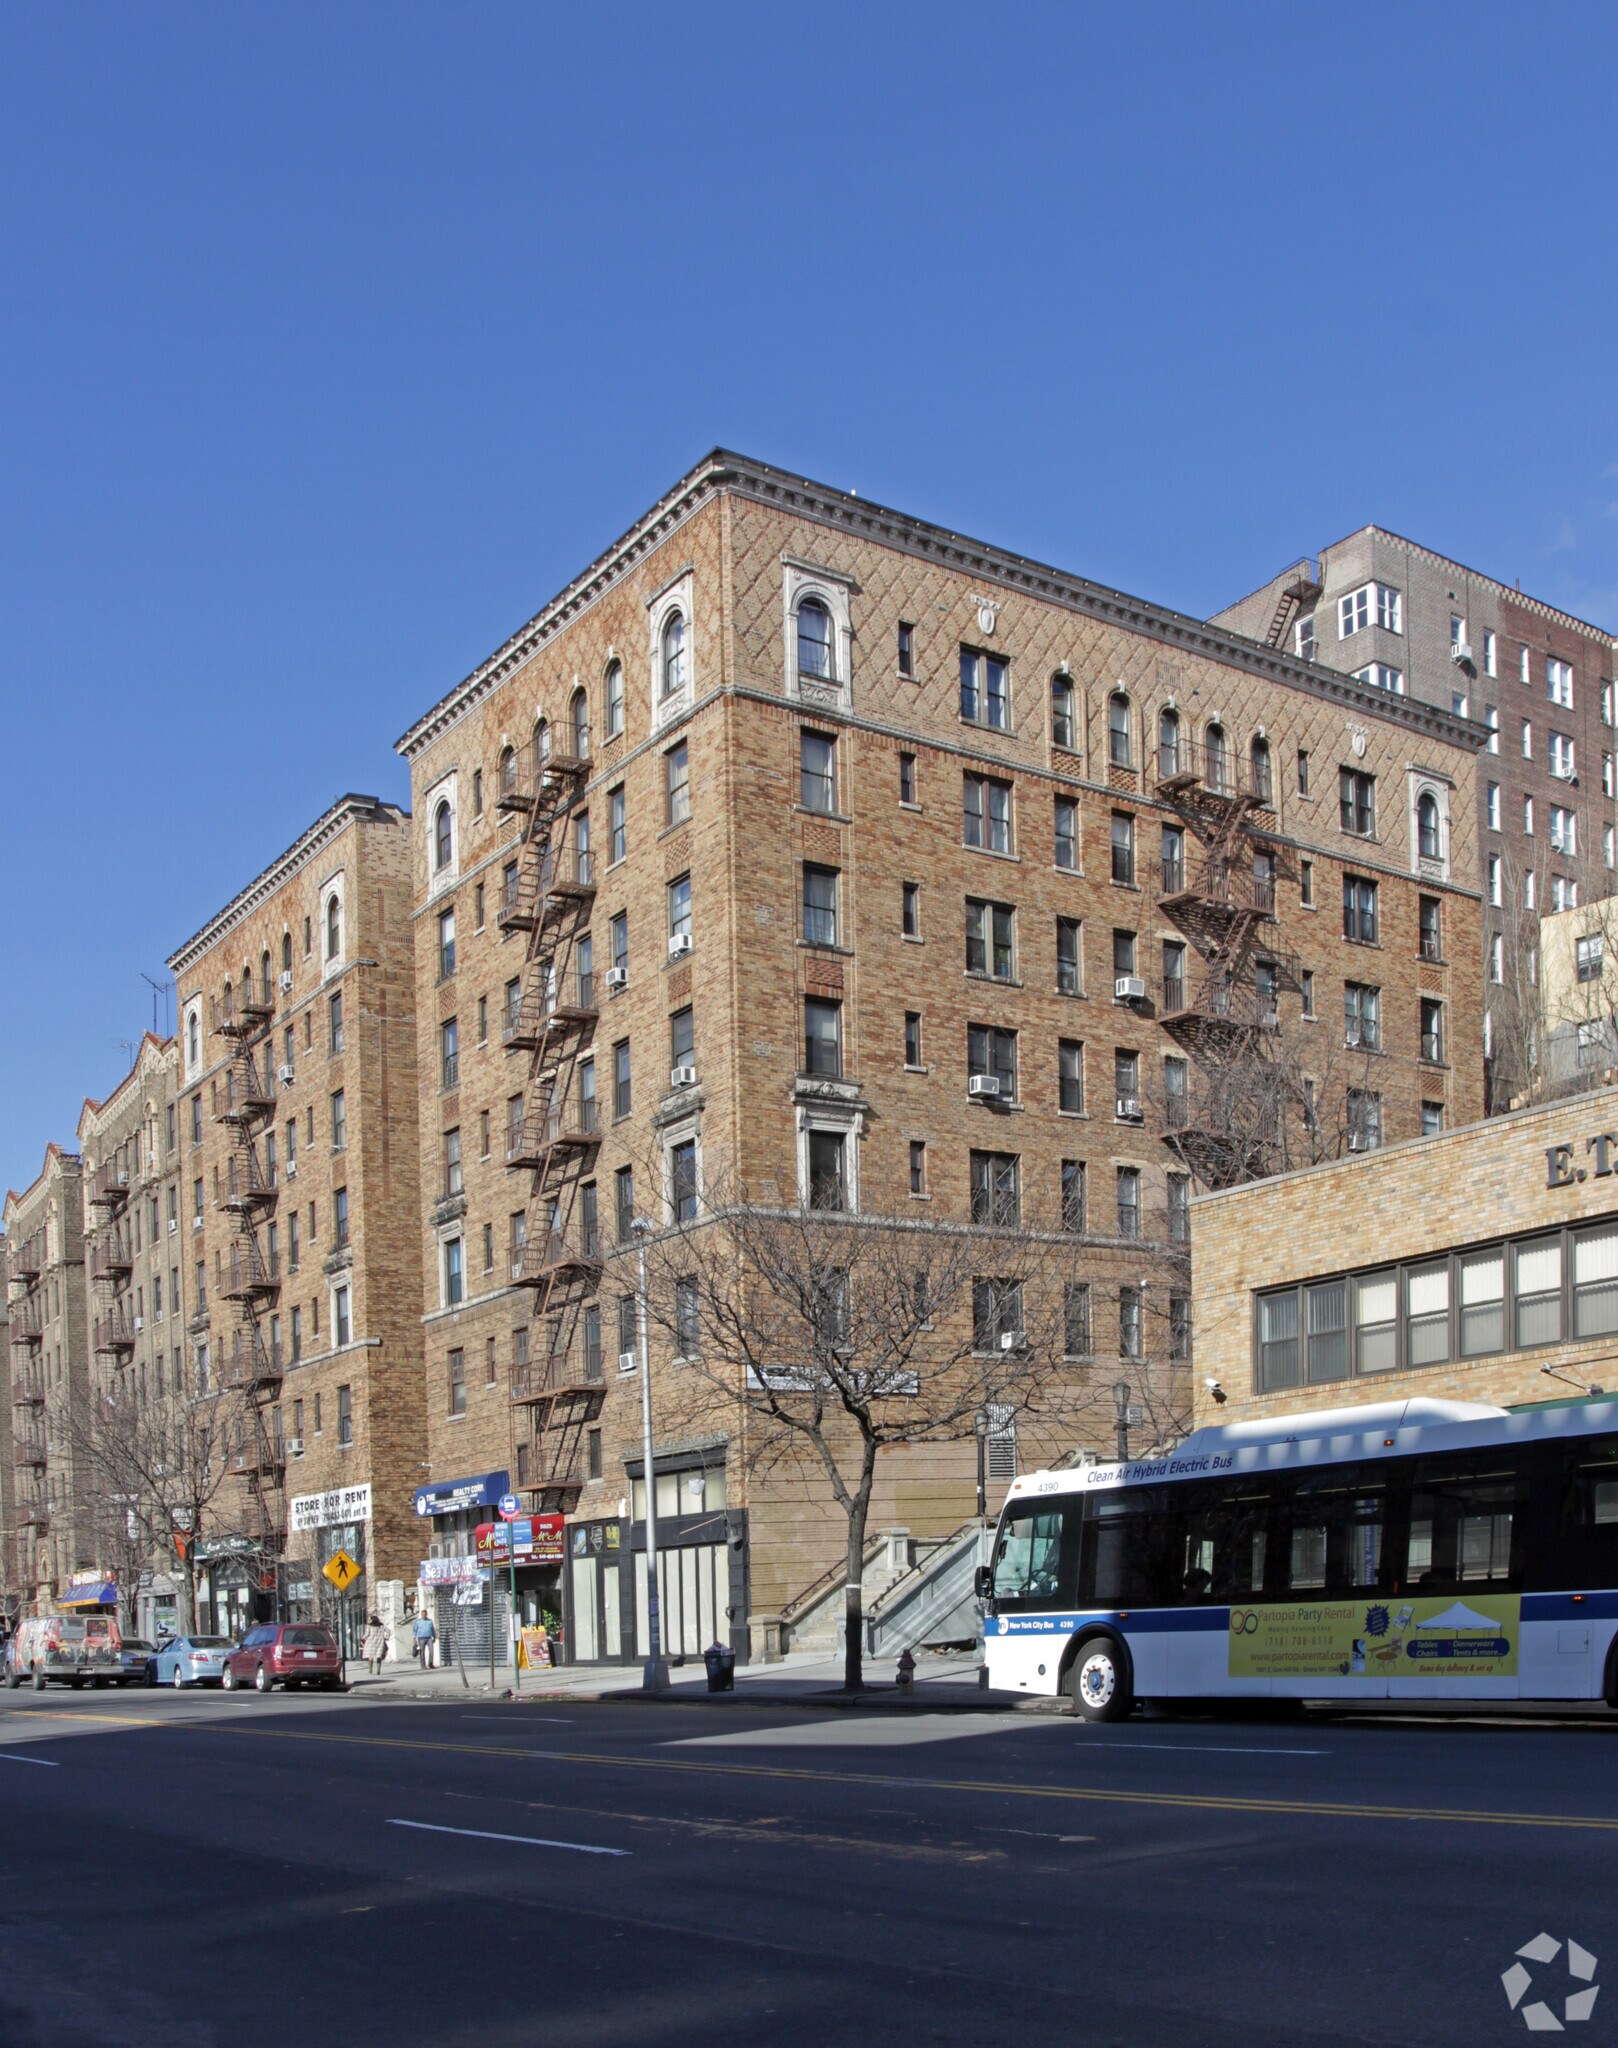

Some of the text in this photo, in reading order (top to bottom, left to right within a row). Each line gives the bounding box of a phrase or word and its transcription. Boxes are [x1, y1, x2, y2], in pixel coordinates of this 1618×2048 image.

[1087, 1456, 1233, 1483] Clean Air Hybrid Electric Bus
[453, 1486, 471, 1497] REALTY
[1038, 1481, 1059, 1492] 4390
[295, 1489, 367, 1513] STORE FOR RENT
[425, 1564, 441, 1578] Sea
[1258, 1606, 1355, 1623] Partopia Party Rental
[1021, 1621, 1032, 1629] York
[1032, 1621, 1043, 1630] City
[1044, 1621, 1054, 1629] Bus
[1265, 1636, 1288, 1646] (718)
[1417, 1641, 1438, 1649] Tables
[1453, 1640, 1495, 1648] Dinnerware
[1250, 1650, 1349, 1662] www.partopiarental.com
[1453, 1649, 1471, 1657] Tents
[1436, 1664, 1445, 1674] day
[1447, 1662, 1469, 1674] delivery
